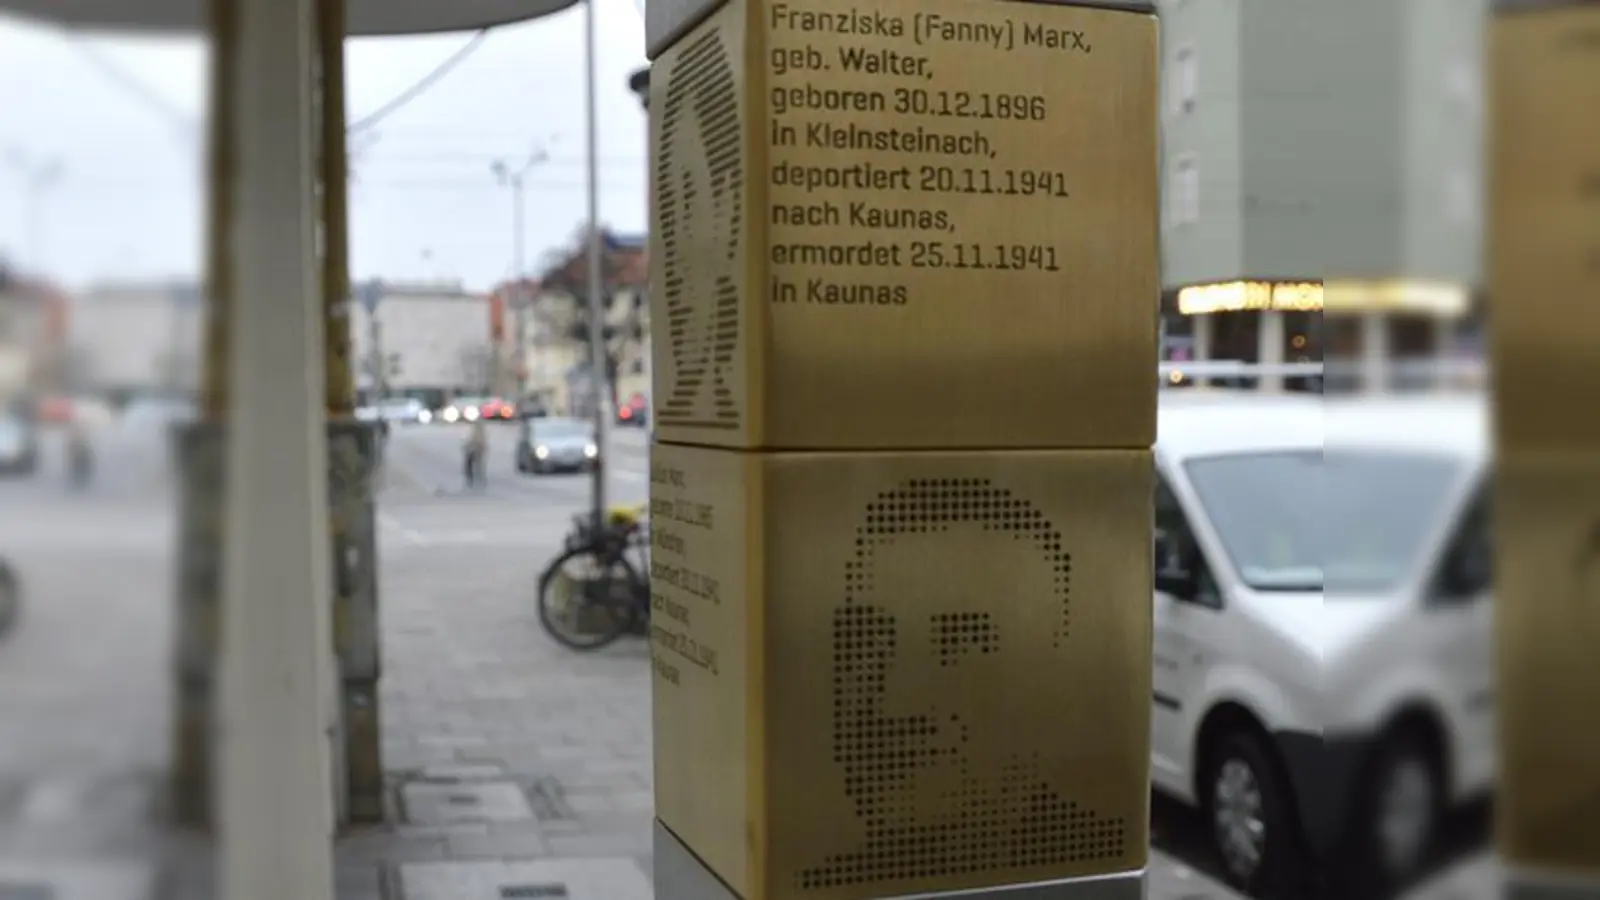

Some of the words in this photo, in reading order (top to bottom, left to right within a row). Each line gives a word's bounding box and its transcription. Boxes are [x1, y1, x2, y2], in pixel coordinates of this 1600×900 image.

[771, 4, 904, 37] Franziska
[913, 13, 1015, 51] (Fanny)
[1023, 24, 1092, 53] Marx,
[771, 46, 829, 74] geb.
[840, 48, 933, 79] Walter,
[771, 87, 885, 114] geboren
[894, 90, 1045, 121] 30.12.1896
[772, 120, 796, 146] in
[807, 123, 997, 158] Kleinsteinach,
[771, 162, 910, 195] deportiert
[920, 168, 1069, 197] 20.11.1941
[772, 202, 839, 226] nach
[850, 205, 955, 233] Kaunas,
[771, 241, 901, 268] ermordet
[910, 243, 1059, 271] 25.11.1941
[772, 277, 797, 303] in
[807, 278, 907, 305] Kaunas
